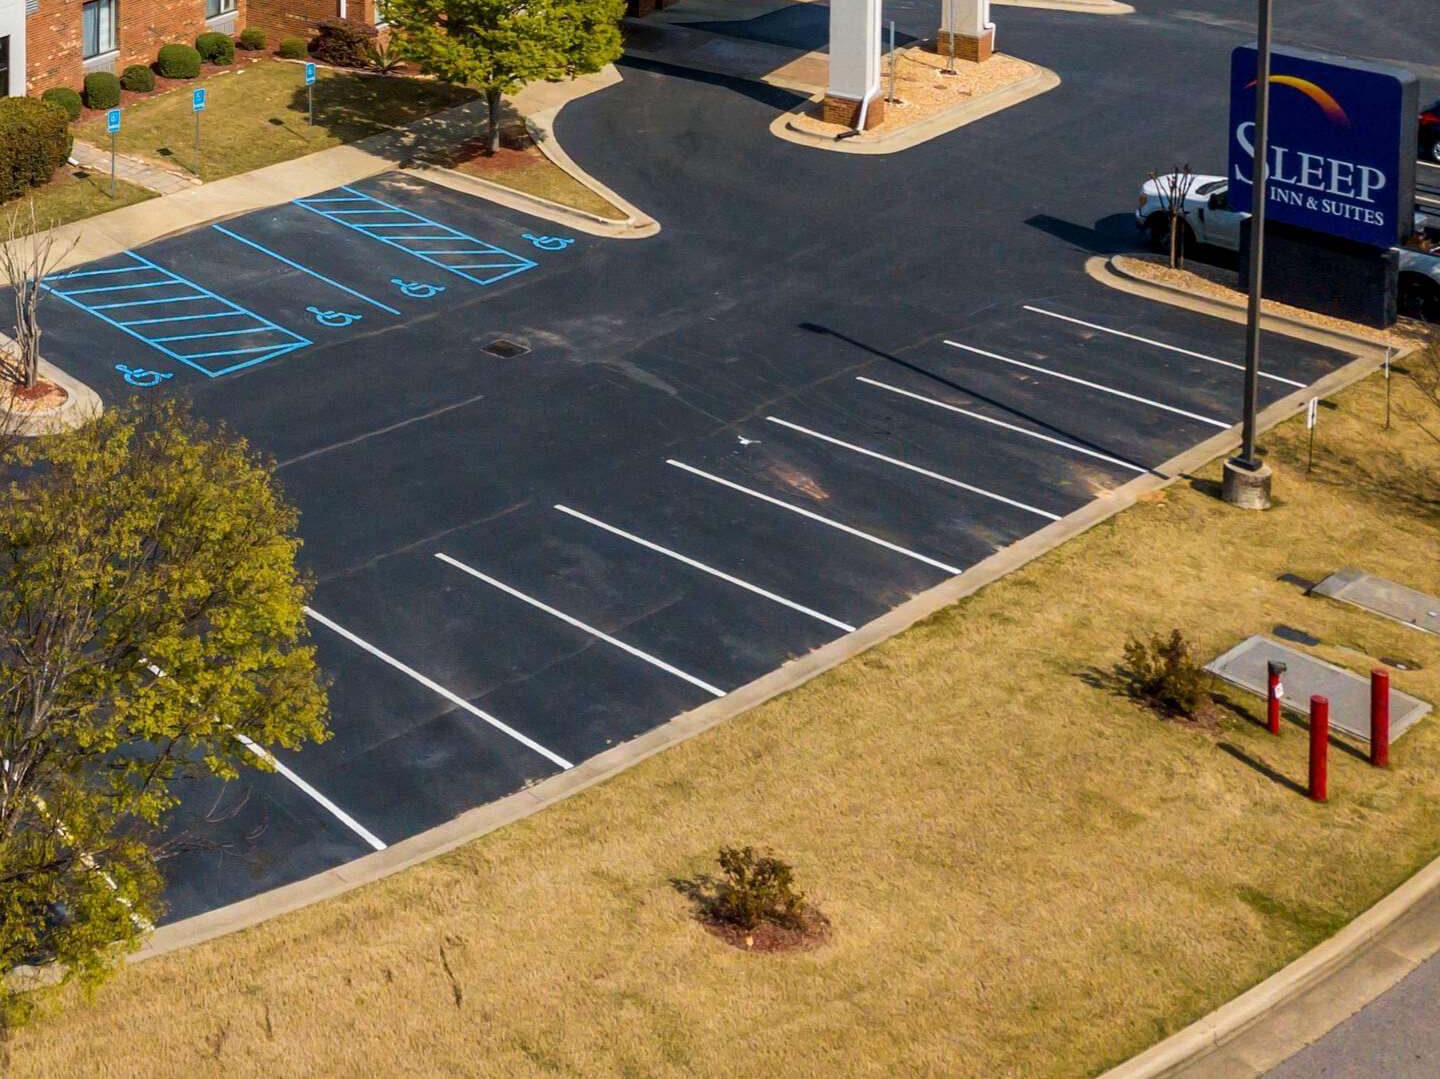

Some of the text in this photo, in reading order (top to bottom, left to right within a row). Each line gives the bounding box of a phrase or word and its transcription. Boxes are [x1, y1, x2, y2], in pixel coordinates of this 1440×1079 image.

[1234, 121, 1387, 204] SLEEP
[1270, 186, 1385, 226] INN & SUITES
